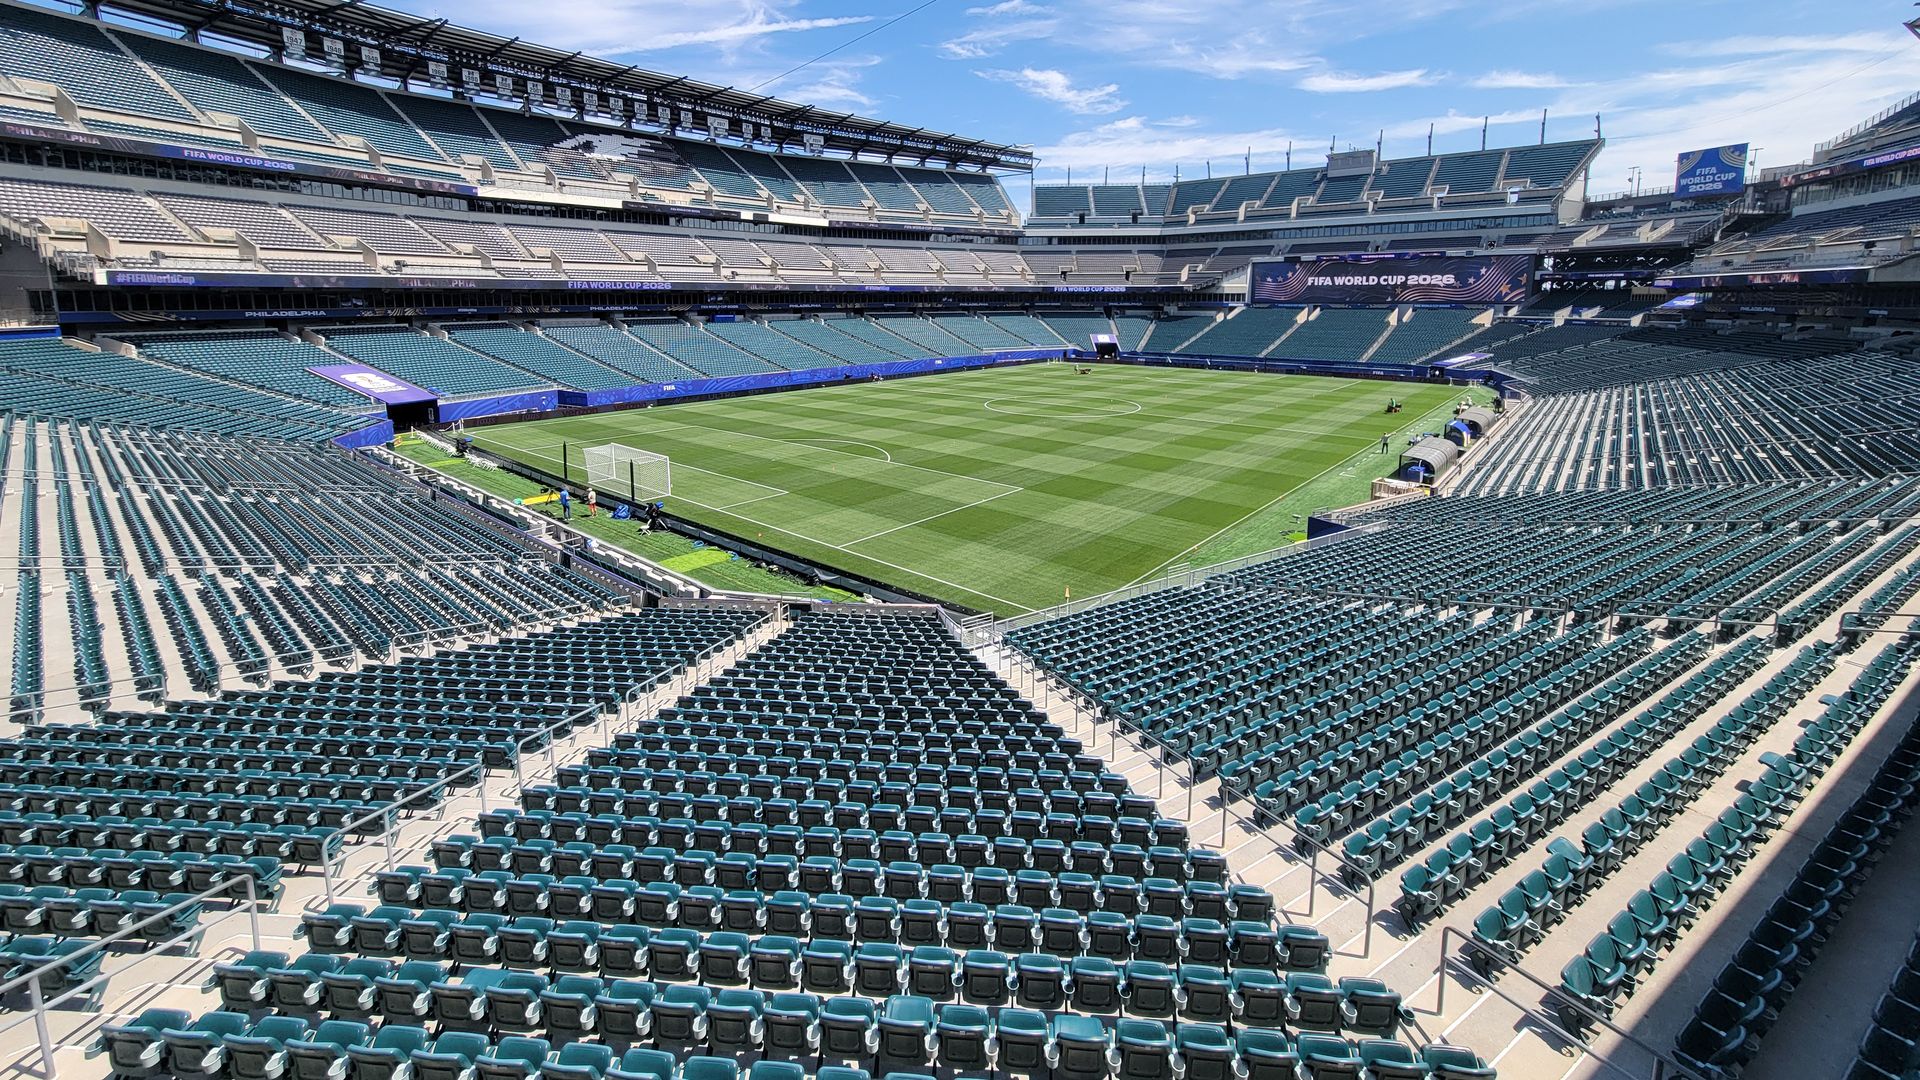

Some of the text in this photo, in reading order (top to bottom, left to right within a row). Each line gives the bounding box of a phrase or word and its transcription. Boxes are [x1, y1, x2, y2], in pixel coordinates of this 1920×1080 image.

[286, 35, 303, 45] 1947
[184, 149, 296, 170] FIFA WORLD CUP 2026
[1696, 167, 1717, 176] FIFA
[1680, 172, 1737, 185] WORLD CUP
[1689, 182, 1723, 192] 2026
[116, 272, 195, 285] #FIFAWorldCup
[1307, 274, 1455, 286] FIFA WORLD CUP 2026
[568, 281, 672, 290] FIFA WORLD CUP 2026
